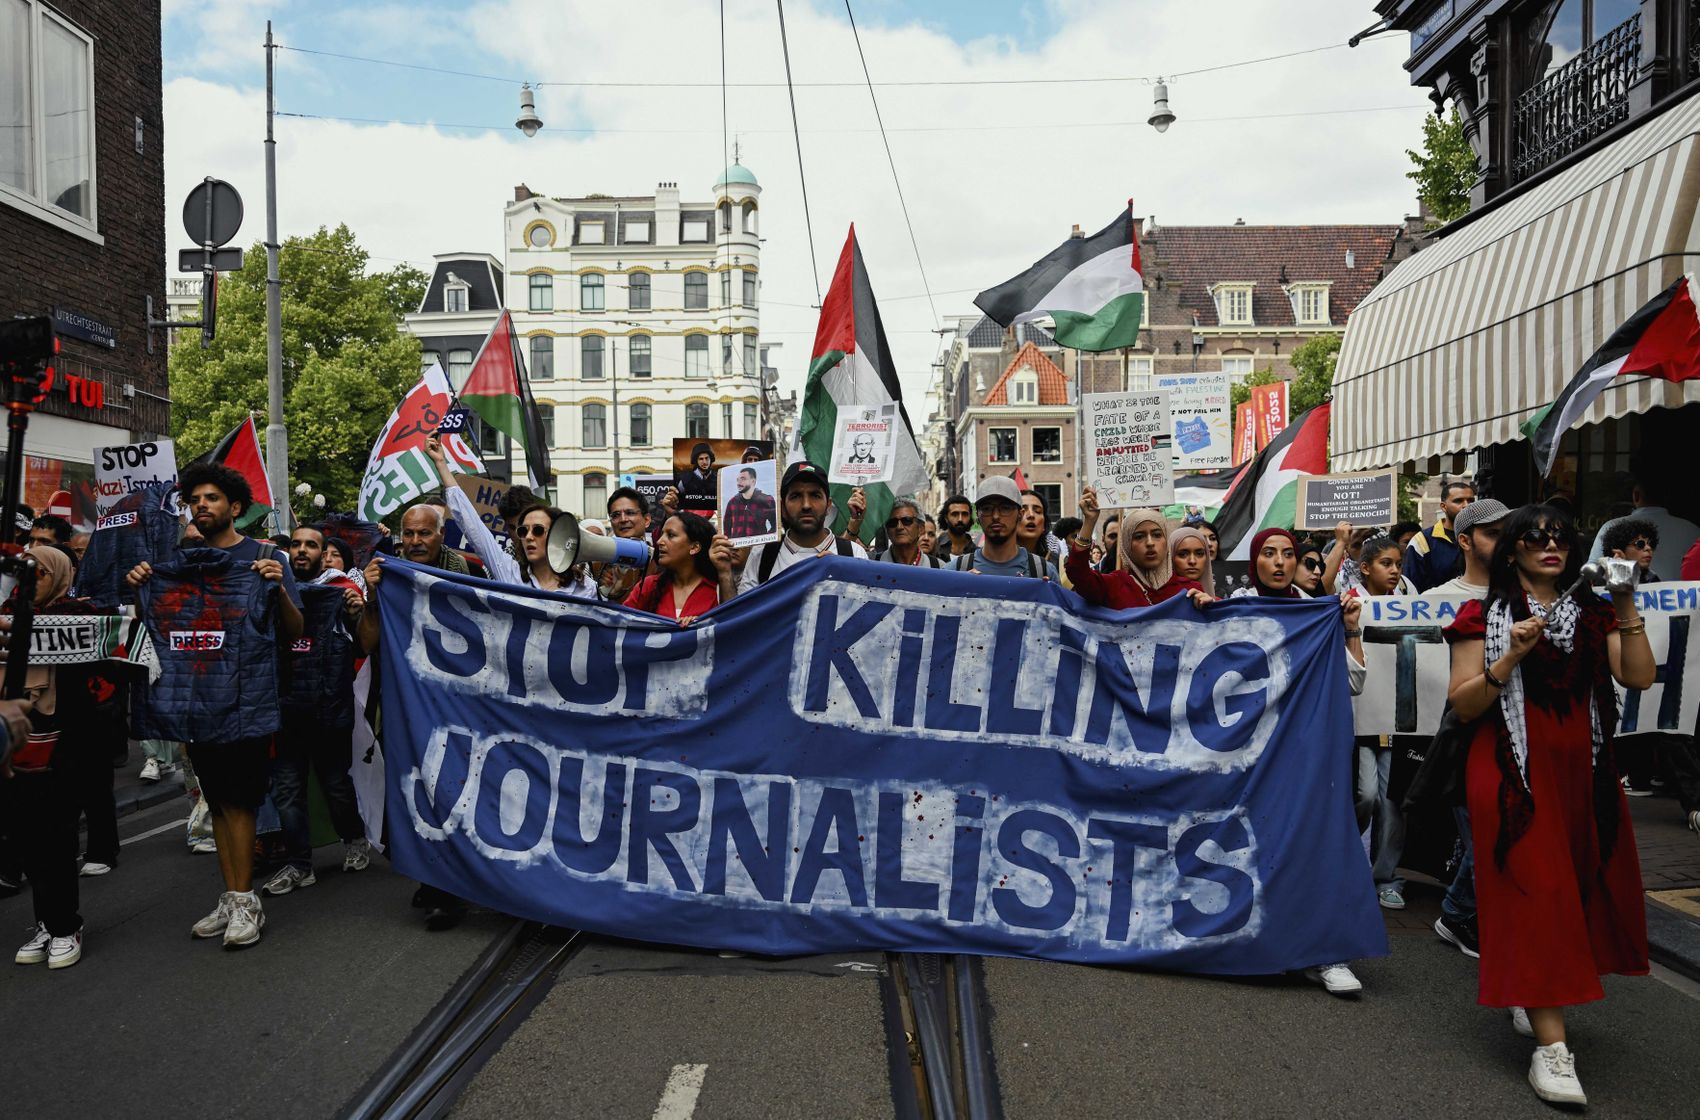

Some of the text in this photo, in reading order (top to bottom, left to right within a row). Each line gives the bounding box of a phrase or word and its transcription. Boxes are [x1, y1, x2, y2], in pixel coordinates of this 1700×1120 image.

[64, 373, 104, 409] TUI
[1093, 400, 1123, 411] WHAT
[1126, 399, 1138, 407] IS
[1140, 396, 1160, 406] THE
[1094, 413, 1127, 426] FATE
[1134, 411, 1150, 422] OF
[1153, 410, 1160, 420] A
[1094, 422, 1160, 437] CHILD WHOSE
[1095, 433, 1150, 448] LEGS WERE
[102, 443, 158, 471] STOP
[1096, 455, 1139, 466] BEFORE
[1097, 461, 1165, 477] LEARNED TO
[1327, 477, 1376, 485] GOVERNMENTS
[1333, 492, 1360, 500] NOT!
[98, 513, 135, 528] PRESS
[1350, 509, 1390, 518] GENOCIDE
[172, 634, 222, 650] PRESS
[423, 582, 700, 711] STOP
